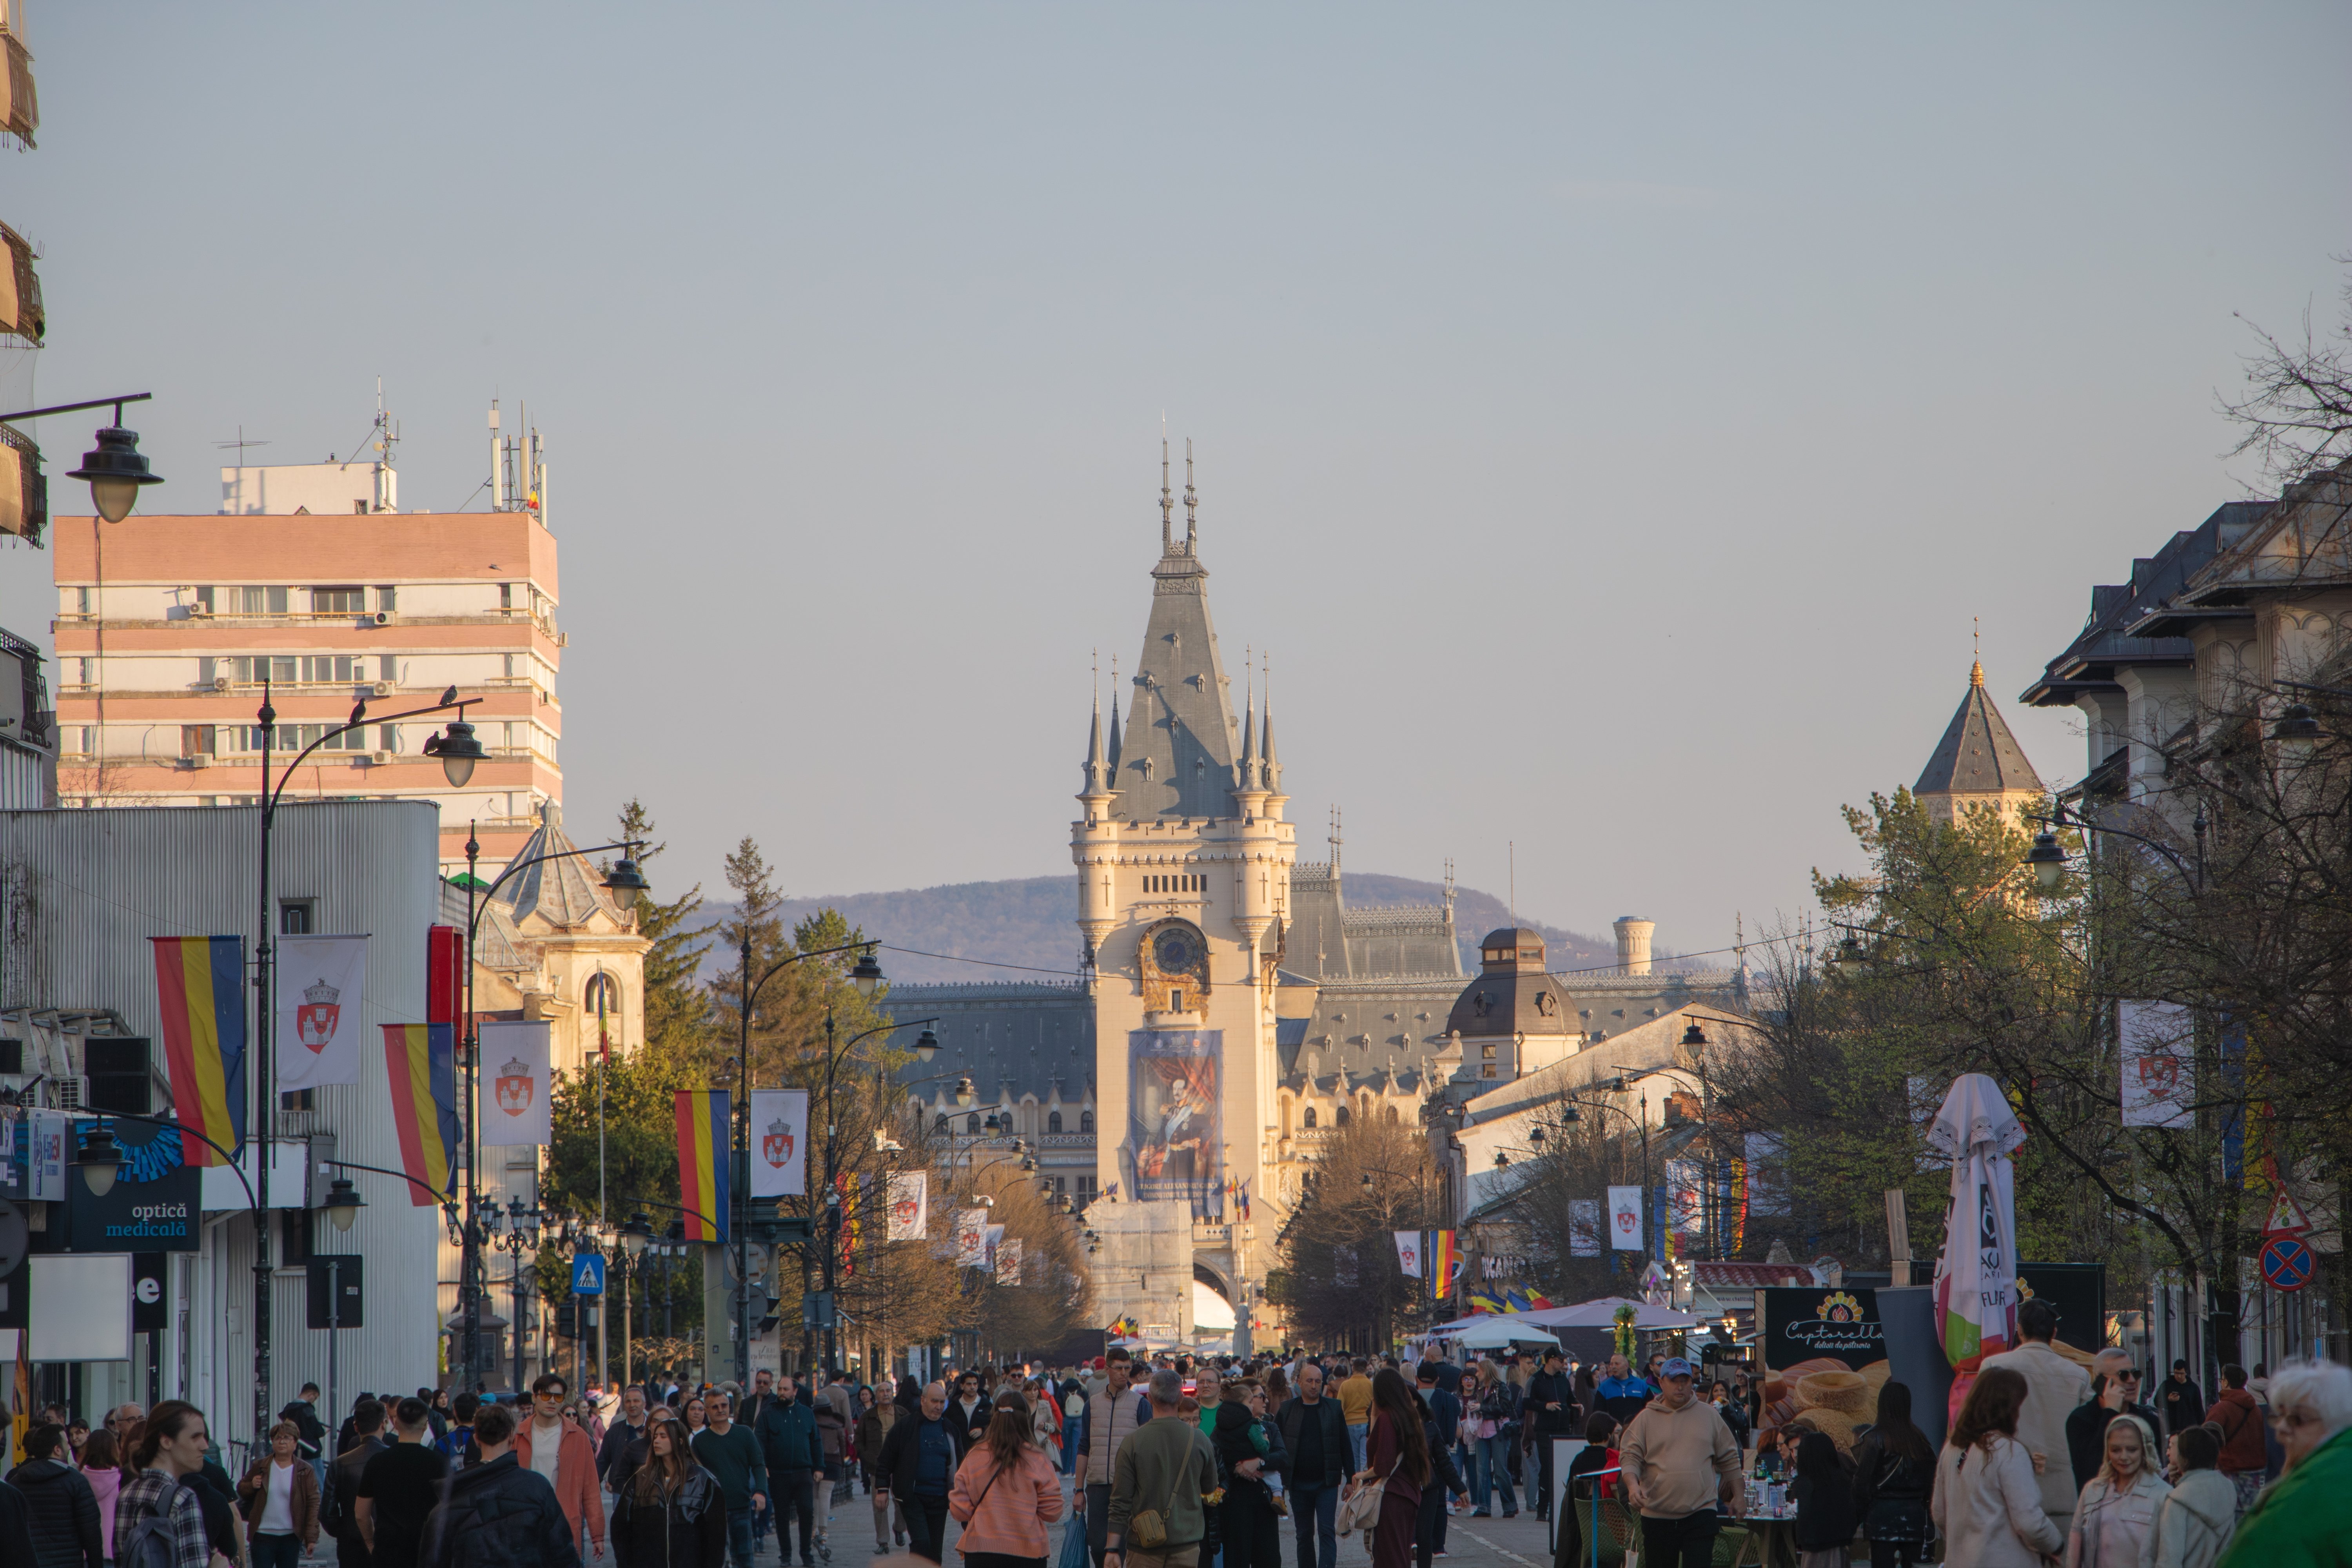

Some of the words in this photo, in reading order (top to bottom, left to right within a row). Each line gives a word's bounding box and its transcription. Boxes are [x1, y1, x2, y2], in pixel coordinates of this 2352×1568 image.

[132, 1203, 187, 1221] optică
[105, 1221, 187, 1236] medicală
[1982, 1270, 2000, 1280] ARI
[132, 1277, 160, 1304] e
[1785, 1321, 1884, 1345] Cuptorella
[1814, 1340, 1834, 1349] delicii
[1835, 1340, 1843, 1349] de
